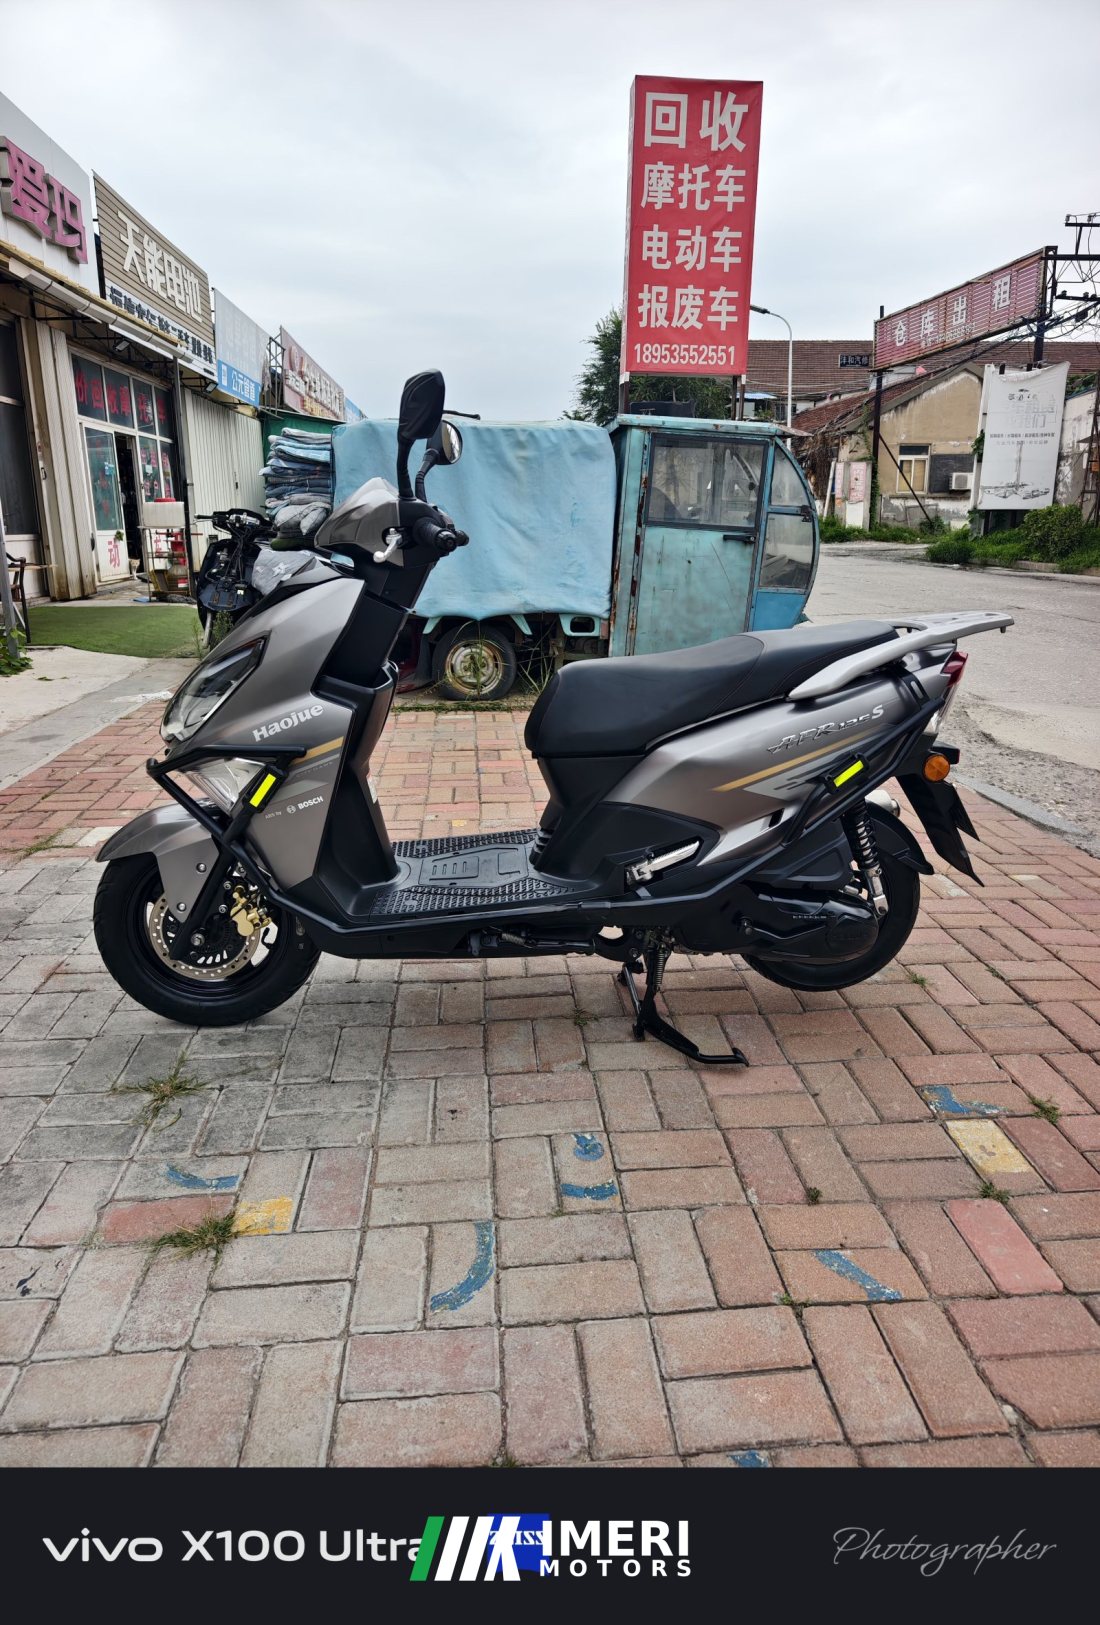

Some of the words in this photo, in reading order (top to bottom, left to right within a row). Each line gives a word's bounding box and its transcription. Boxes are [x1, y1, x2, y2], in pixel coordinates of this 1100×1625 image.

[644, 91, 749, 152] 回收
[640, 161, 746, 213] 摩托车
[117, 209, 202, 323] 天能电池
[641, 224, 742, 273] 电动车
[637, 283, 739, 332] 报废车
[894, 273, 1011, 347] 仓库出租
[633, 342, 736, 366] 18953552551
[252, 704, 324, 742] Haojue
[298, 796, 324, 810] BOSCH
